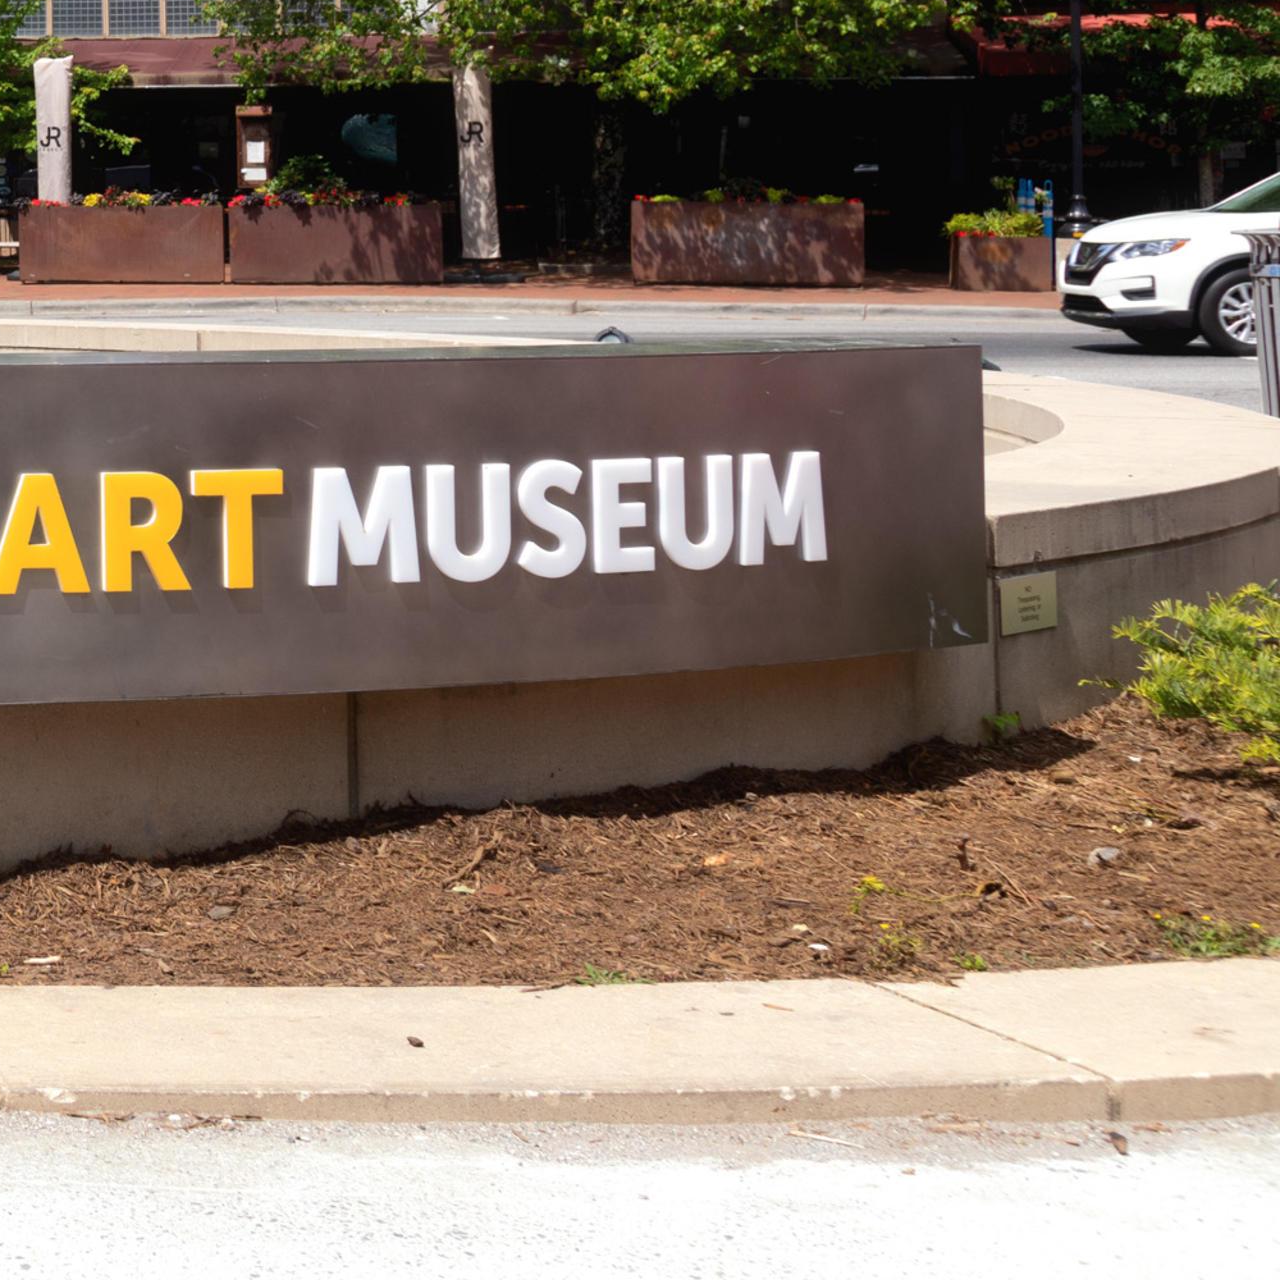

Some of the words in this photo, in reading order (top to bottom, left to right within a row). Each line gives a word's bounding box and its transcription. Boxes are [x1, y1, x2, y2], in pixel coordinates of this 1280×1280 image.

[40, 126, 61, 148] JR
[460, 121, 484, 144] JR
[306, 450, 828, 588] MUSEUM
